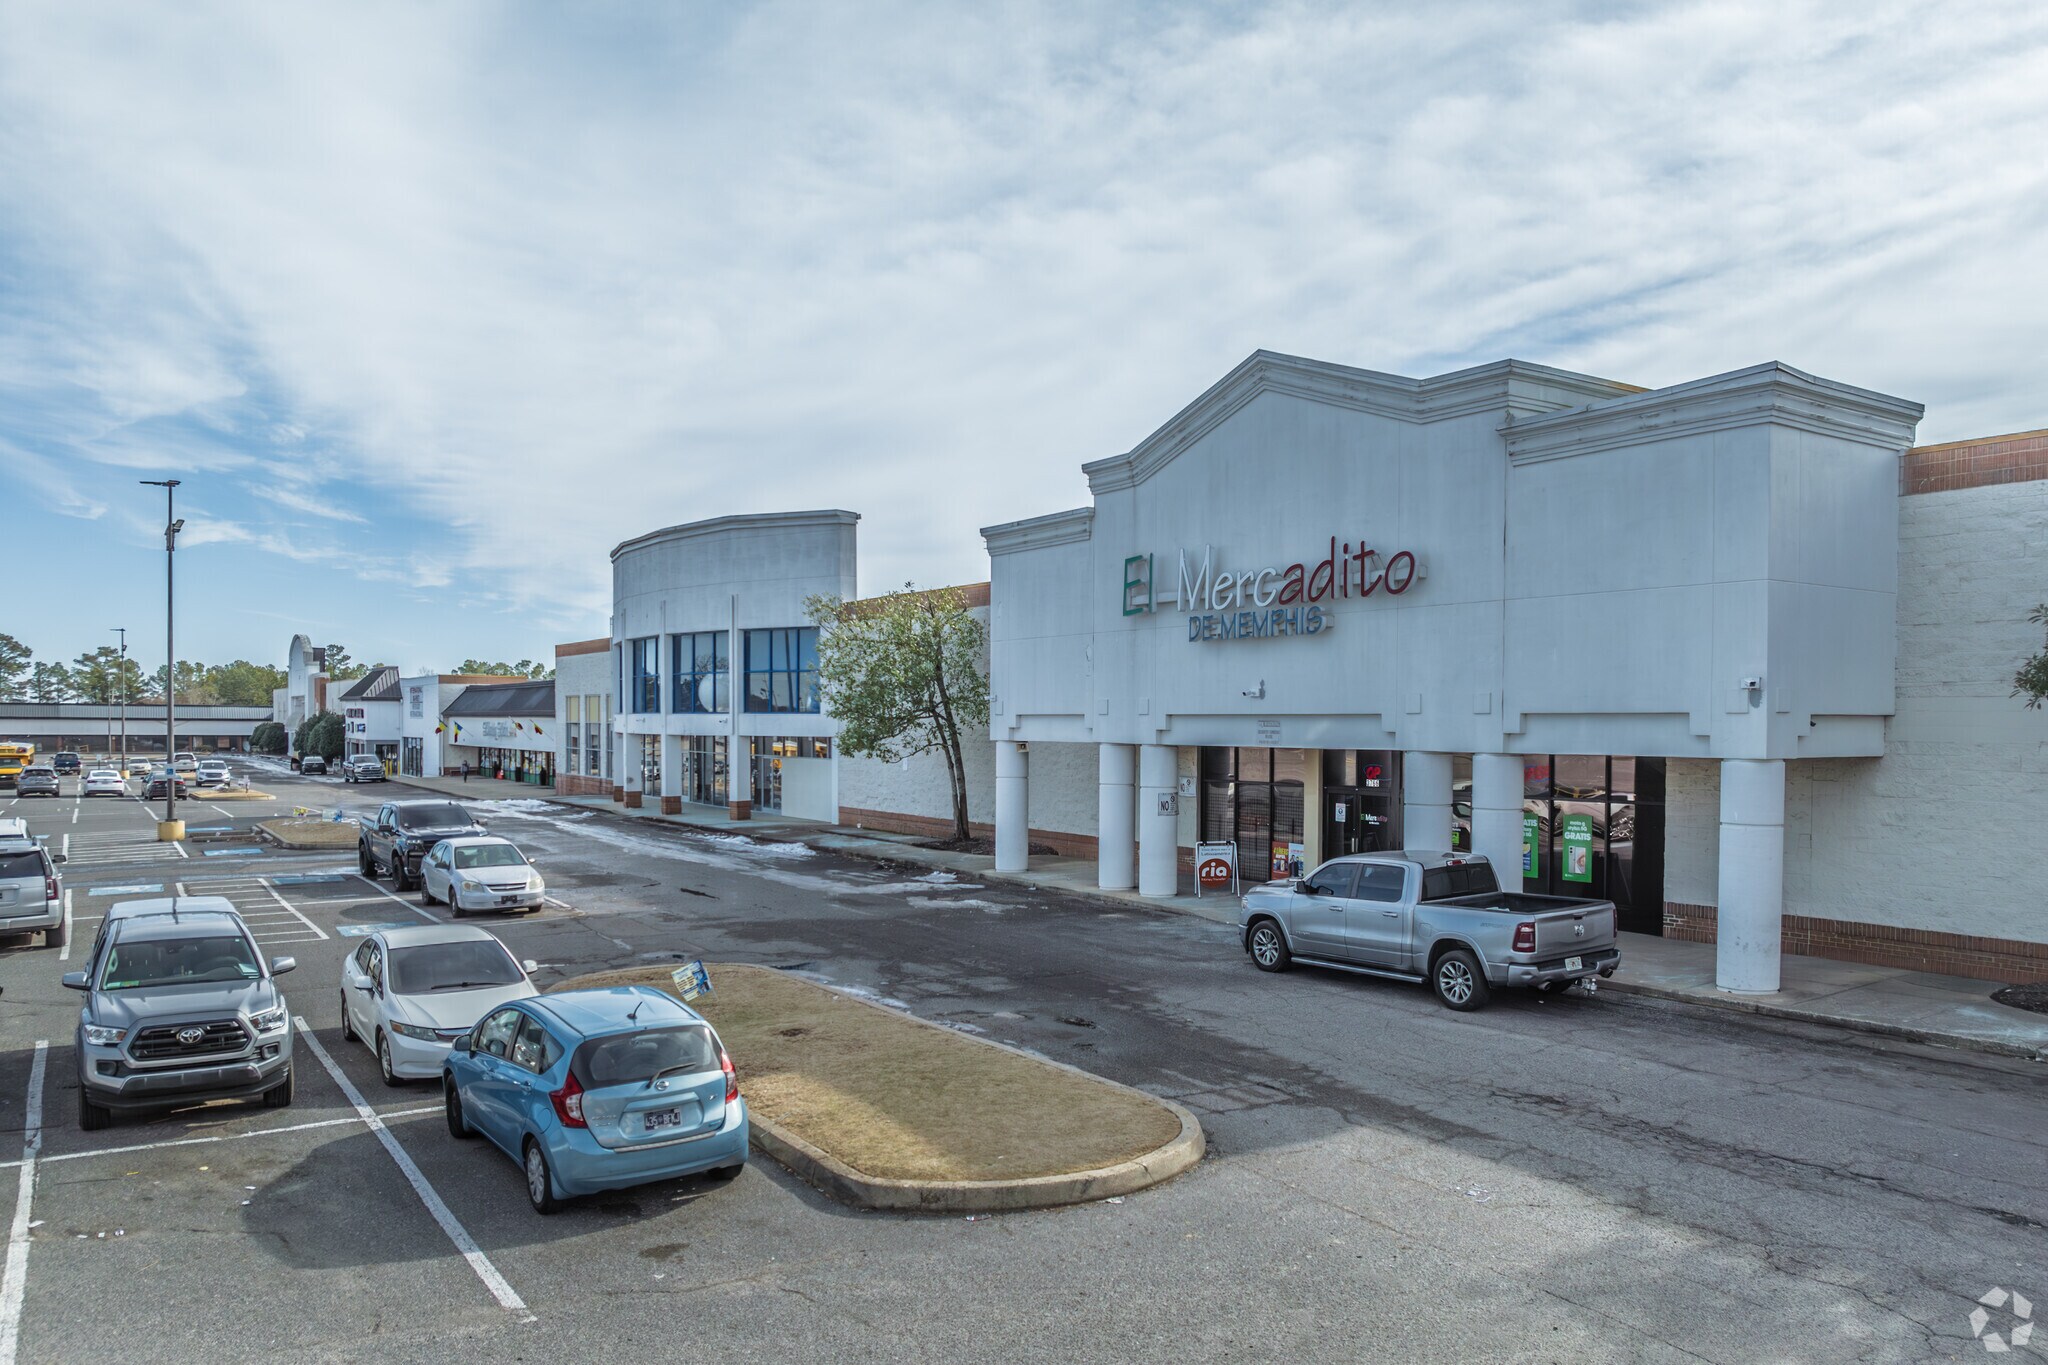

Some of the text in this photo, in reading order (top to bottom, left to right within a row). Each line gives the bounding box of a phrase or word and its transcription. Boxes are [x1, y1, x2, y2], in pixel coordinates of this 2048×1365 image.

[1122, 535, 1416, 617] El Mercadito
[1188, 605, 1324, 643] DE MEMPHIS
[1160, 800, 1170, 811] NO
[1564, 832, 1591, 840] GRATIS
[1201, 861, 1227, 877] ria
